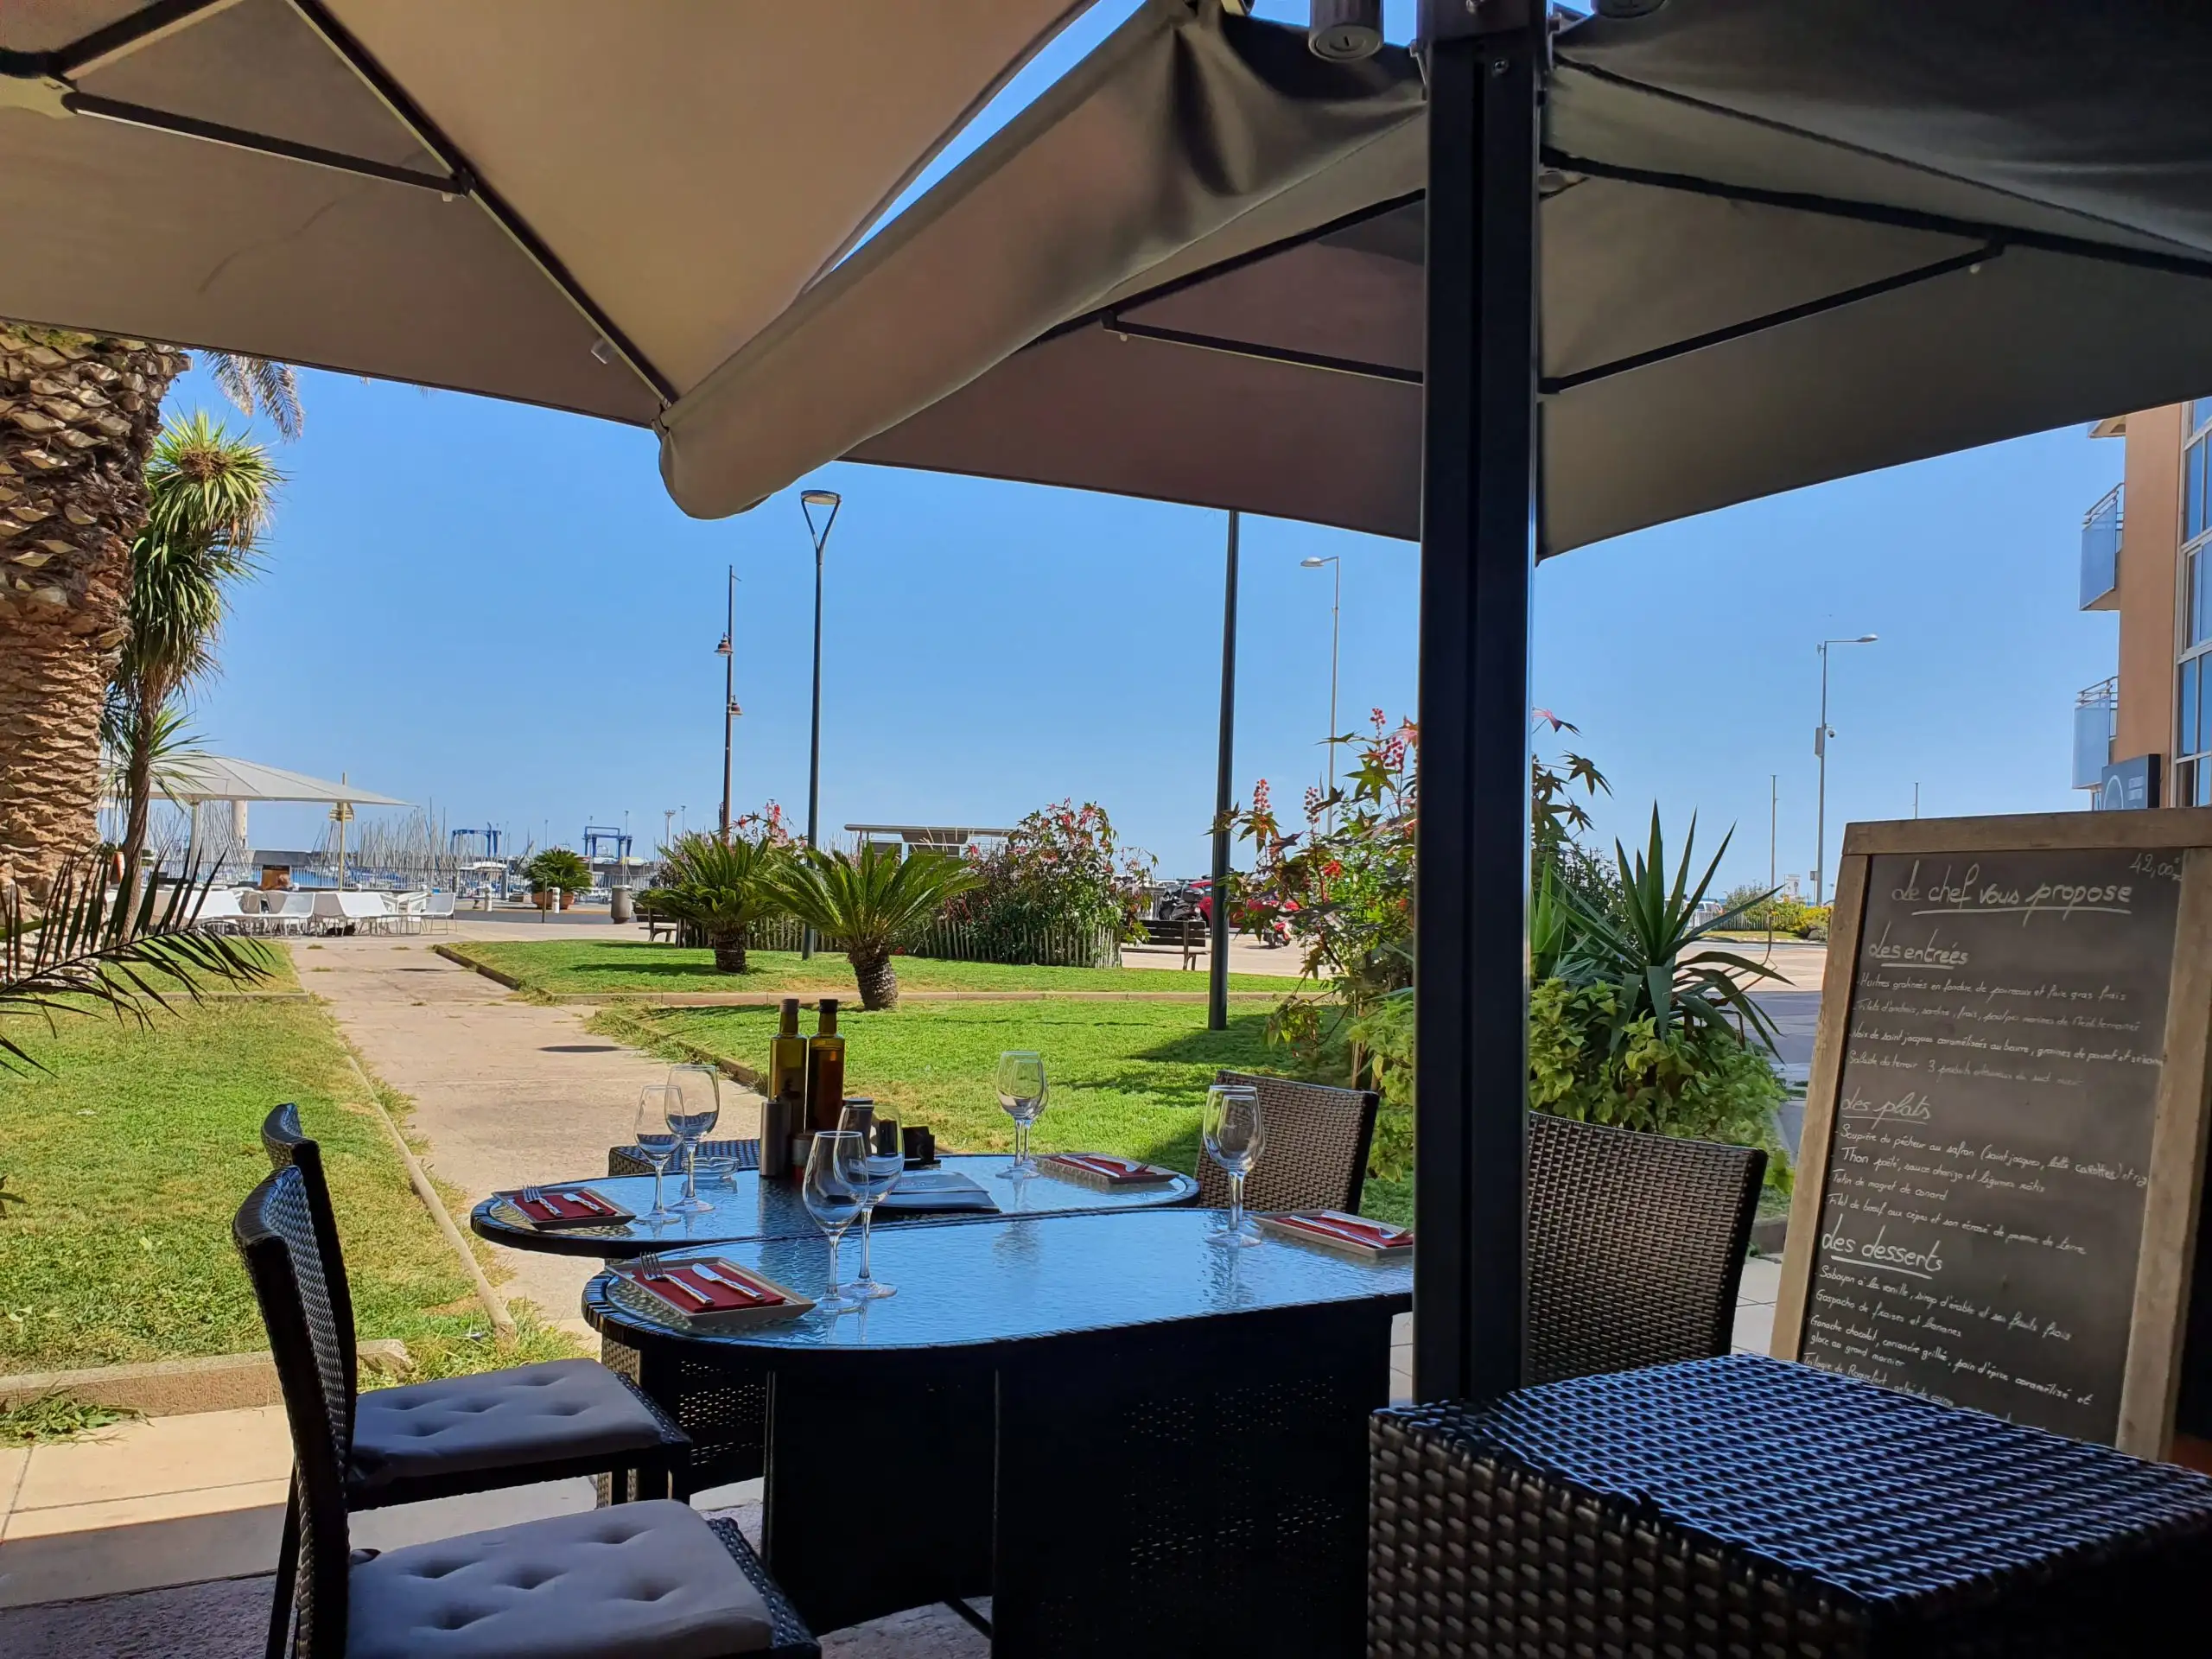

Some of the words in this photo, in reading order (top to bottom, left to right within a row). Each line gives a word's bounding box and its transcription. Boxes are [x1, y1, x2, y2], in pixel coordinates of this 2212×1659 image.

[1928, 863, 1980, 910] chef
[1980, 883, 2020, 905] vous
[2023, 882, 2133, 927] propose
[2070, 991, 2093, 1000] gras
[2098, 985, 2126, 1001] frais
[1861, 1224, 1943, 1272] desserts
